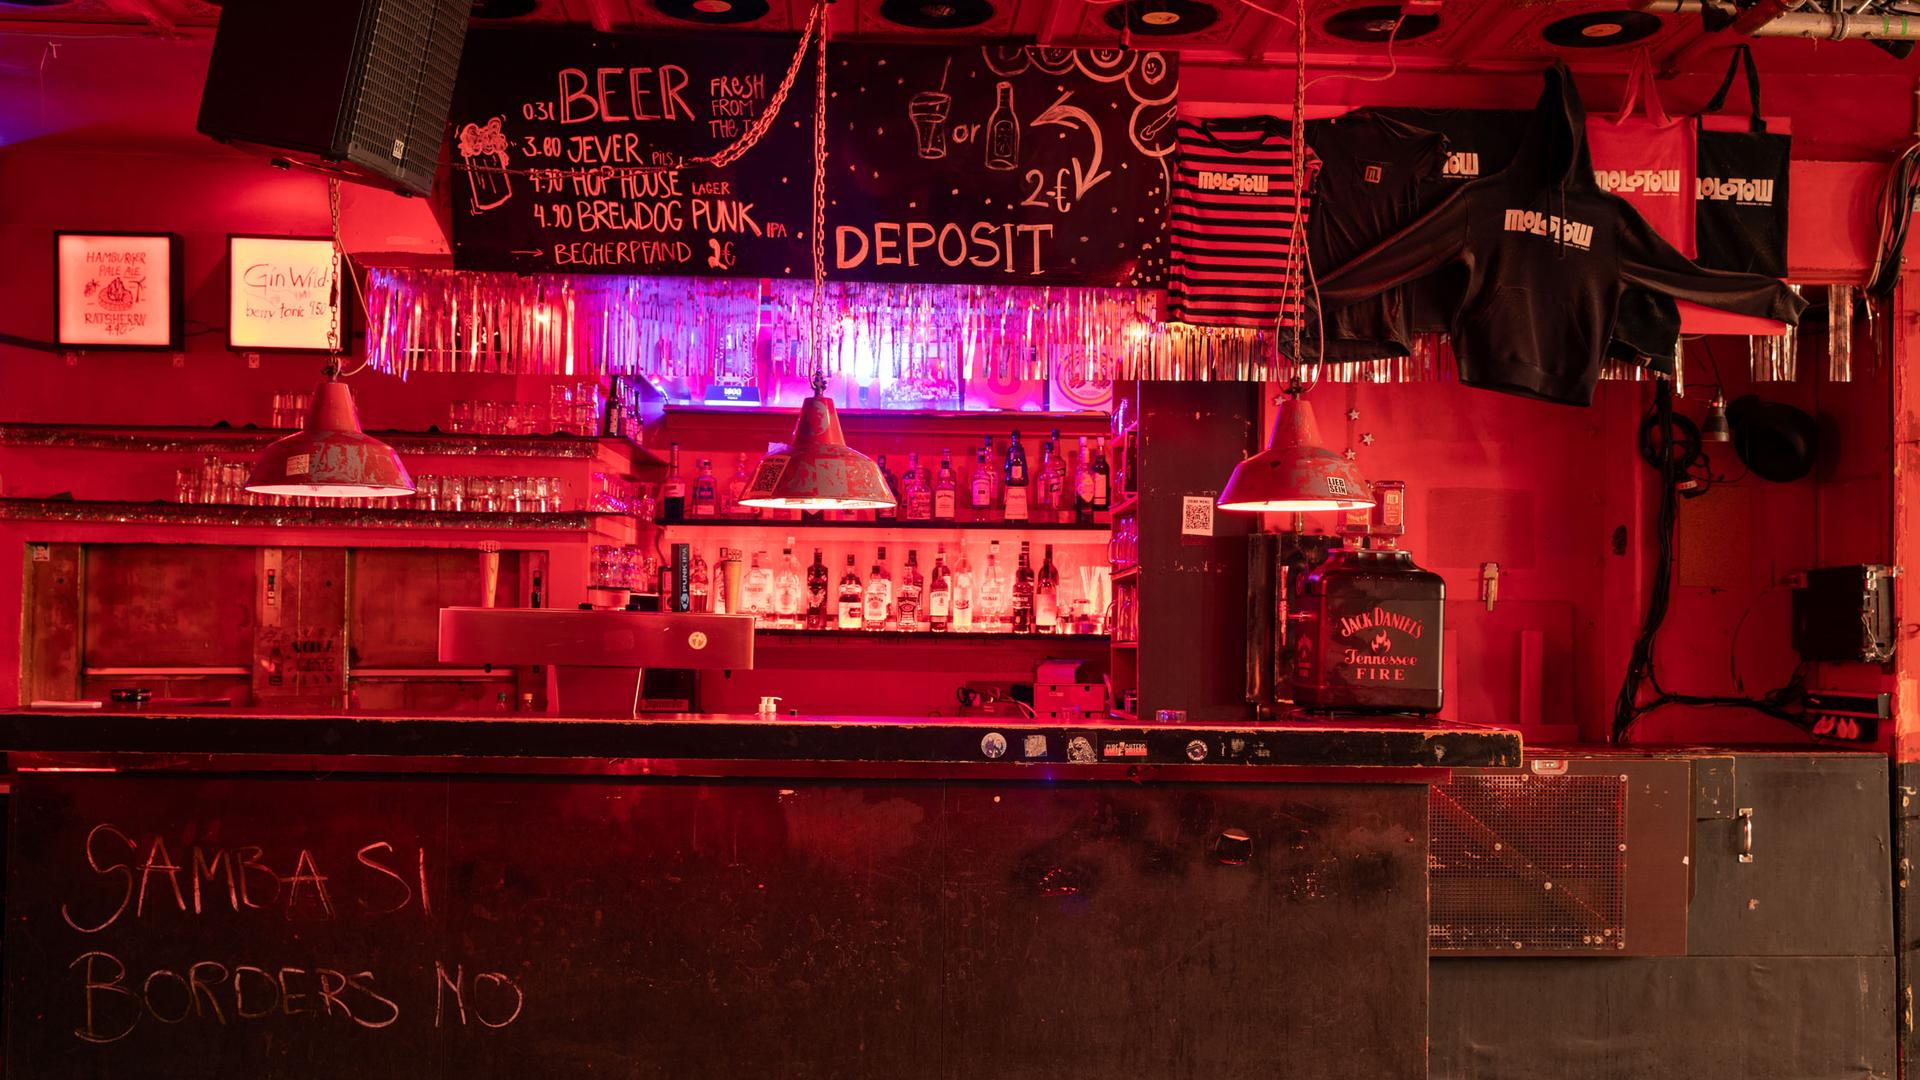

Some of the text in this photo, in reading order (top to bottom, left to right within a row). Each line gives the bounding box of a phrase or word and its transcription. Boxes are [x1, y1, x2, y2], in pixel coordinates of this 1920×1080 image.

[558, 64, 696, 124] BEER
[711, 98, 754, 117] FROM
[952, 123, 981, 144] or
[567, 132, 644, 165] JEVER
[571, 165, 615, 198] HOP
[621, 169, 683, 199] HOUSE
[692, 181, 731, 196] LAGER
[1198, 171, 1269, 193] MOLOTOW
[533, 199, 788, 239] 4.90 BREWDOG PUNK IPA
[86, 251, 147, 266] HAMBURGER
[554, 240, 692, 265] BECHERPFAND
[835, 221, 1054, 276] DEPOSIT
[99, 264, 142, 277] PALE ALE
[243, 263, 286, 297] Gin
[280, 302, 305, 319] tonic
[1327, 477, 1345, 488] LIEB
[1329, 485, 1347, 495] SEIN
[1340, 606, 1424, 640] JACK DANIEL'S
[1344, 648, 1417, 666] Tennessee
[1356, 667, 1405, 681] FIRE
[61, 823, 433, 933] SAMBA SI
[69, 951, 524, 1044] BORDERS NO
